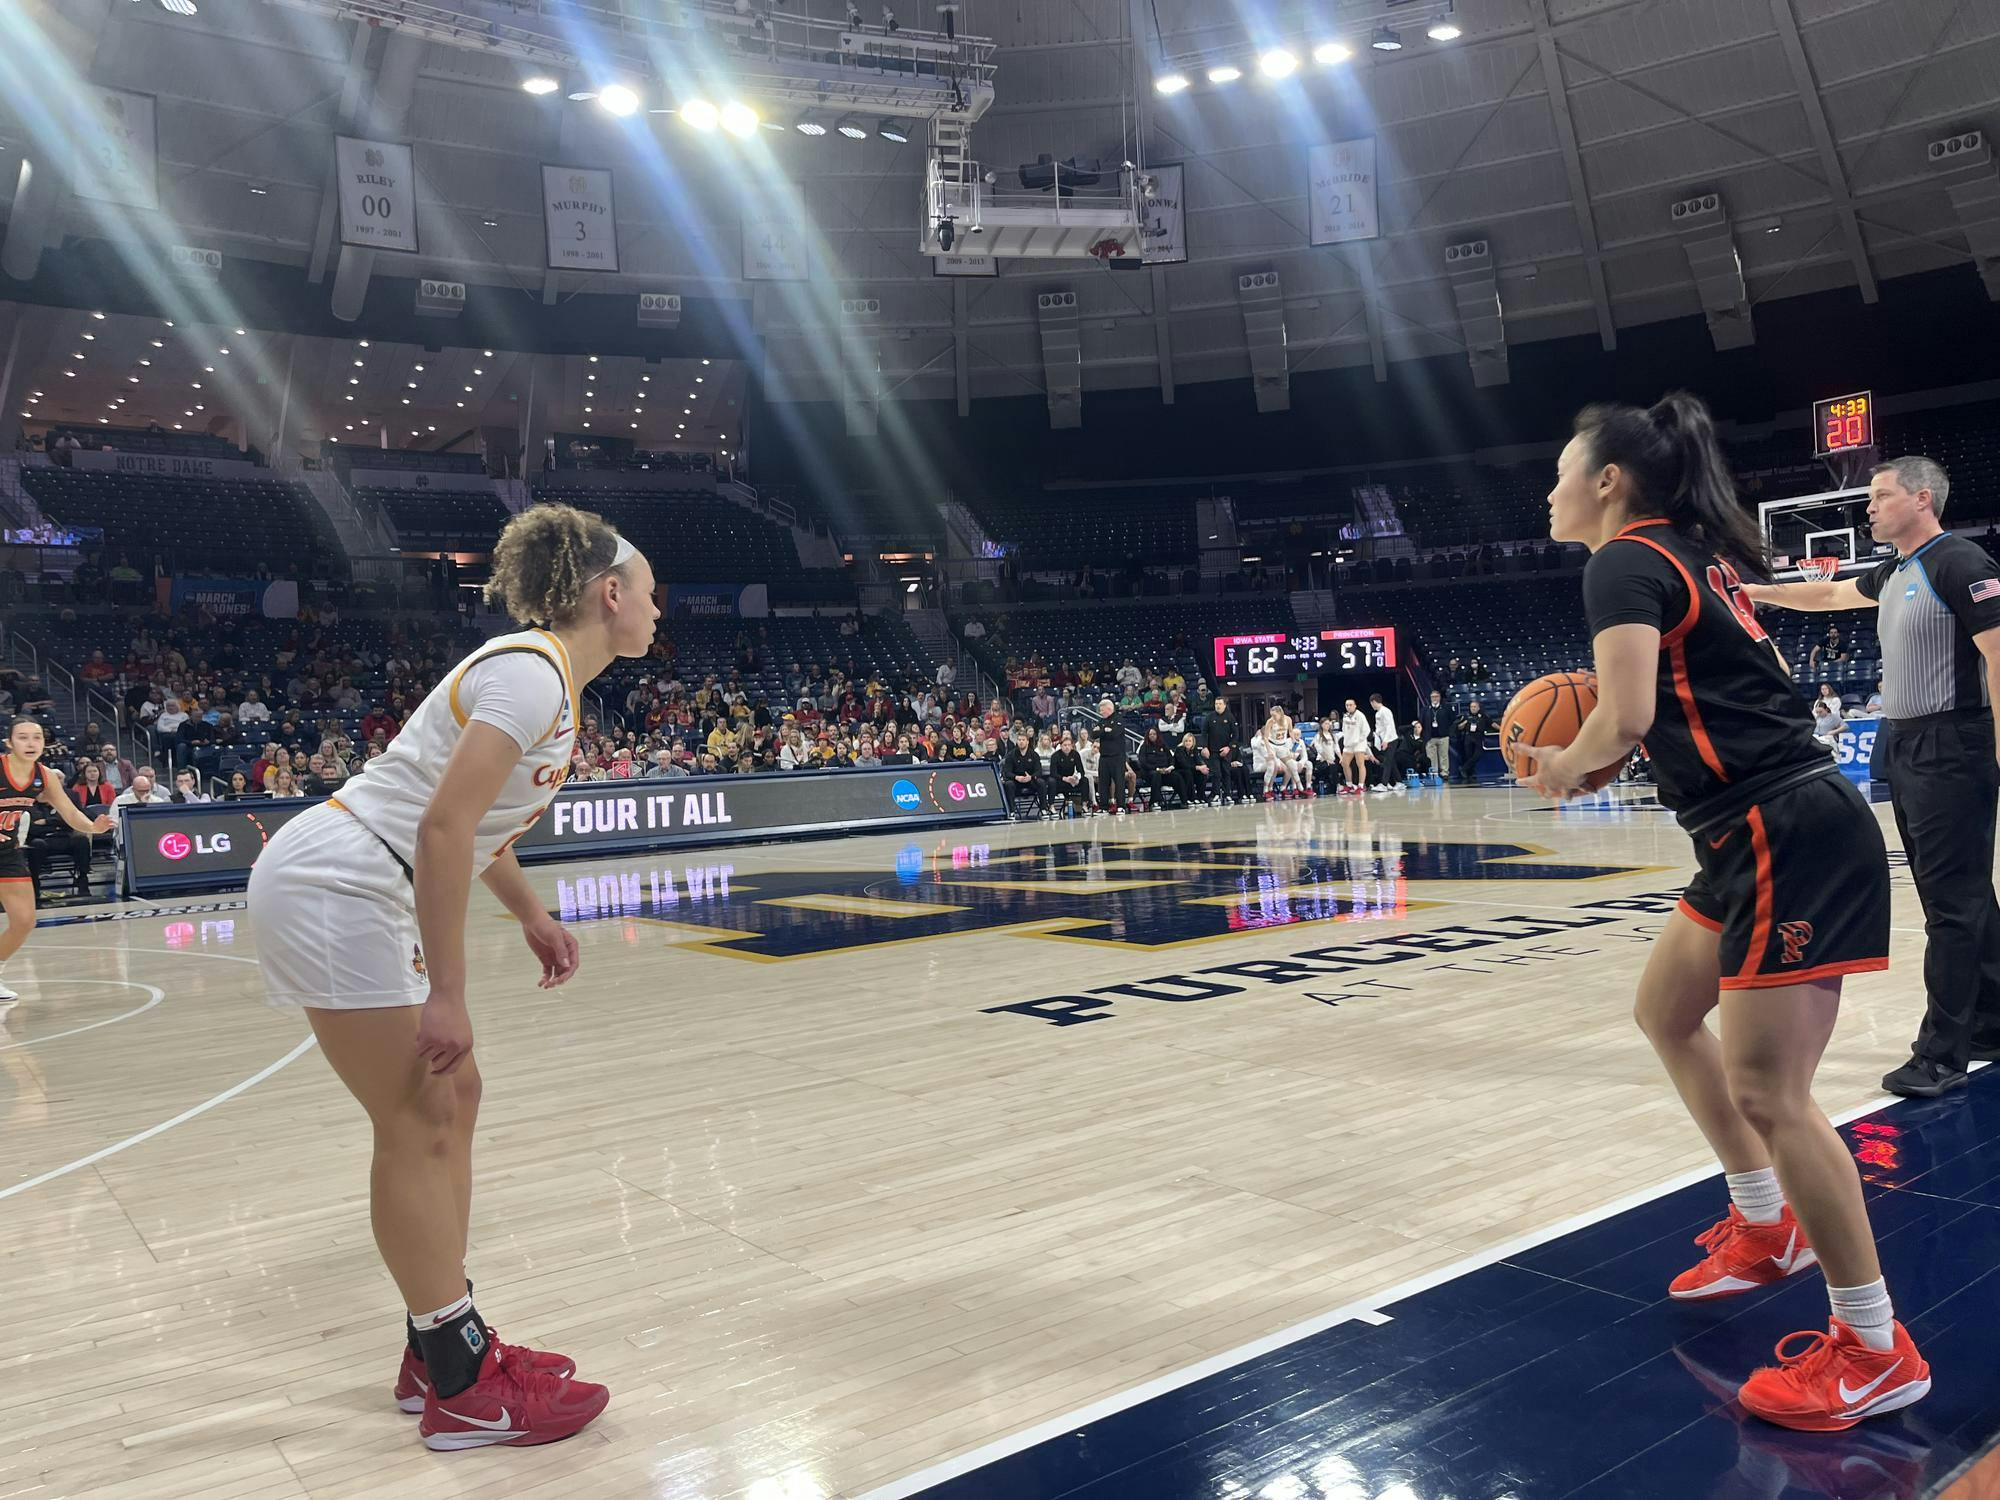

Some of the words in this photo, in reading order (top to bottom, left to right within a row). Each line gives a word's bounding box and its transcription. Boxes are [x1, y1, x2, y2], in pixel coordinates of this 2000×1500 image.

[356, 174, 396, 187] RILEY
[362, 195, 391, 218] 00
[552, 200, 607, 215] MURPHY
[1331, 193, 1354, 215] 21
[575, 221, 586, 241] 3
[1830, 398, 1867, 417] 4:33
[1827, 416, 1863, 448] 20
[116, 456, 166, 472] NOTRE
[173, 458, 213, 475] DAME
[195, 592, 236, 604] MARCH
[687, 596, 717, 605] MARCH
[691, 604, 732, 614] MADNESS
[1233, 637, 1254, 645] IOWA
[1254, 635, 1274, 644] STATE
[1290, 636, 1317, 651] 4:33
[1333, 630, 1374, 639] PRINCETON
[1248, 646, 1278, 674] 62
[1340, 641, 1371, 669] 57
[1376, 656, 1384, 667] 0
[1302, 661, 1308, 670] 4
[895, 793, 920, 803] NCAA
[966, 782, 987, 798] LG
[554, 797, 638, 836] FOUR
[647, 795, 674, 828] IT
[683, 792, 732, 826] ALL
[195, 832, 231, 854] LG
[1776, 920, 1814, 964] P
[977, 914, 1627, 1027] PURCELL
[1302, 978, 1415, 1007] AT
[1423, 945, 1601, 974] THE
